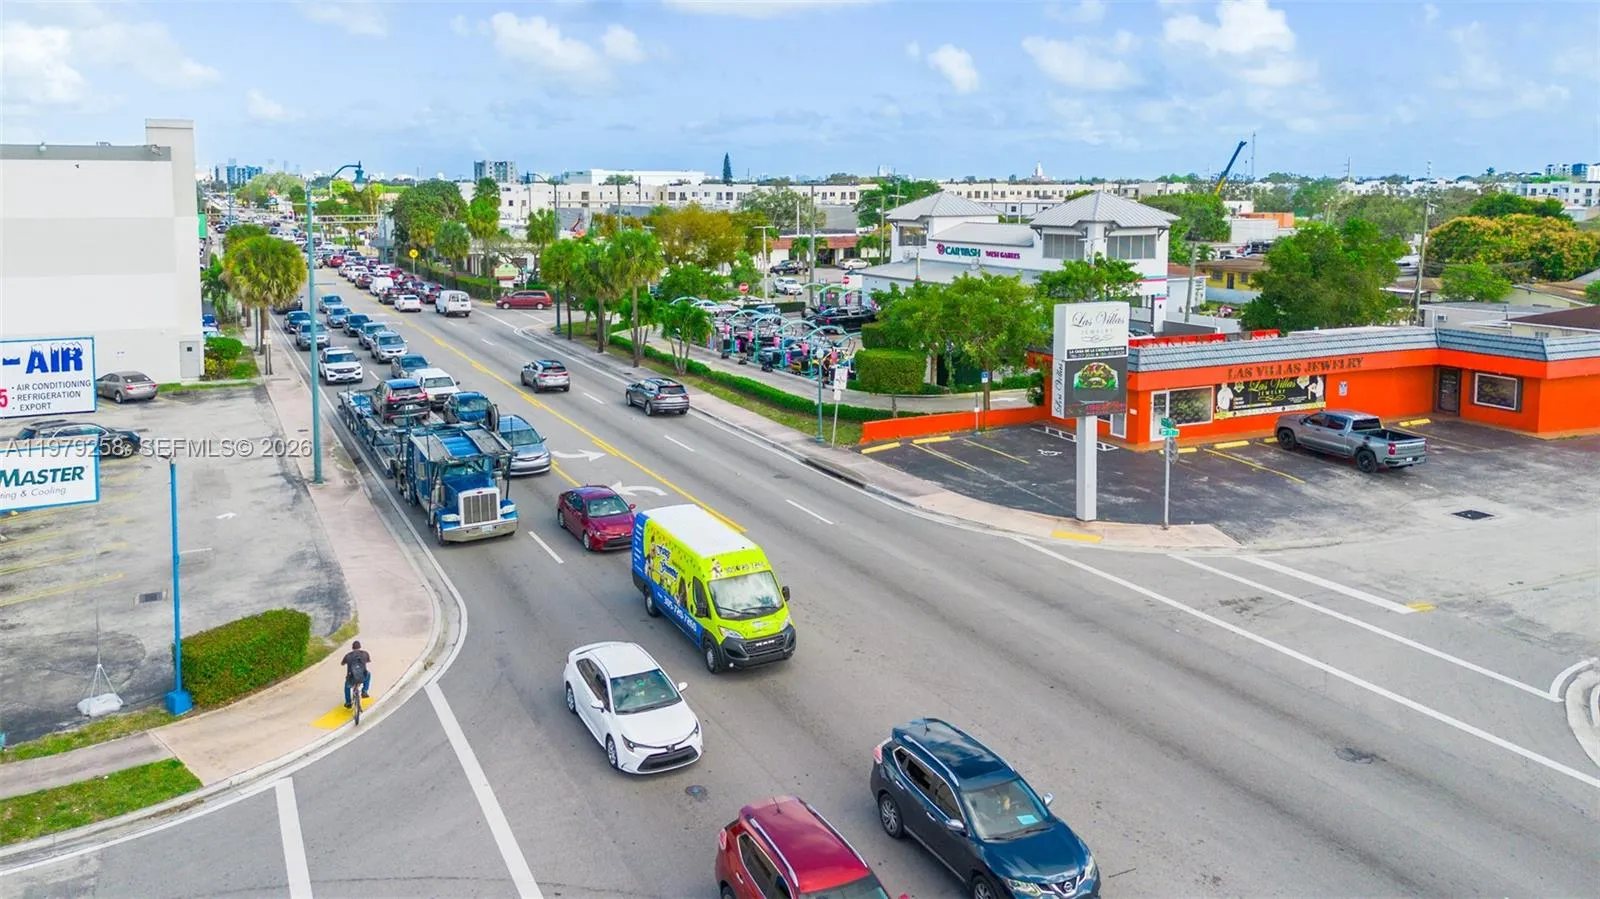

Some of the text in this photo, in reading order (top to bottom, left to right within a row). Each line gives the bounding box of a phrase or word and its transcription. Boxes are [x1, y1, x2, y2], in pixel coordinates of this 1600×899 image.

[1227, 357, 1364, 380] LAS VILLAS JEWELRY
[16, 380, 91, 391] AIR CONDITIONING
[17, 391, 81, 401] REFRIGERATION
[20, 402, 52, 411] EXPORT
[20, 489, 27, 498] &
[31, 486, 66, 496] Cooling
